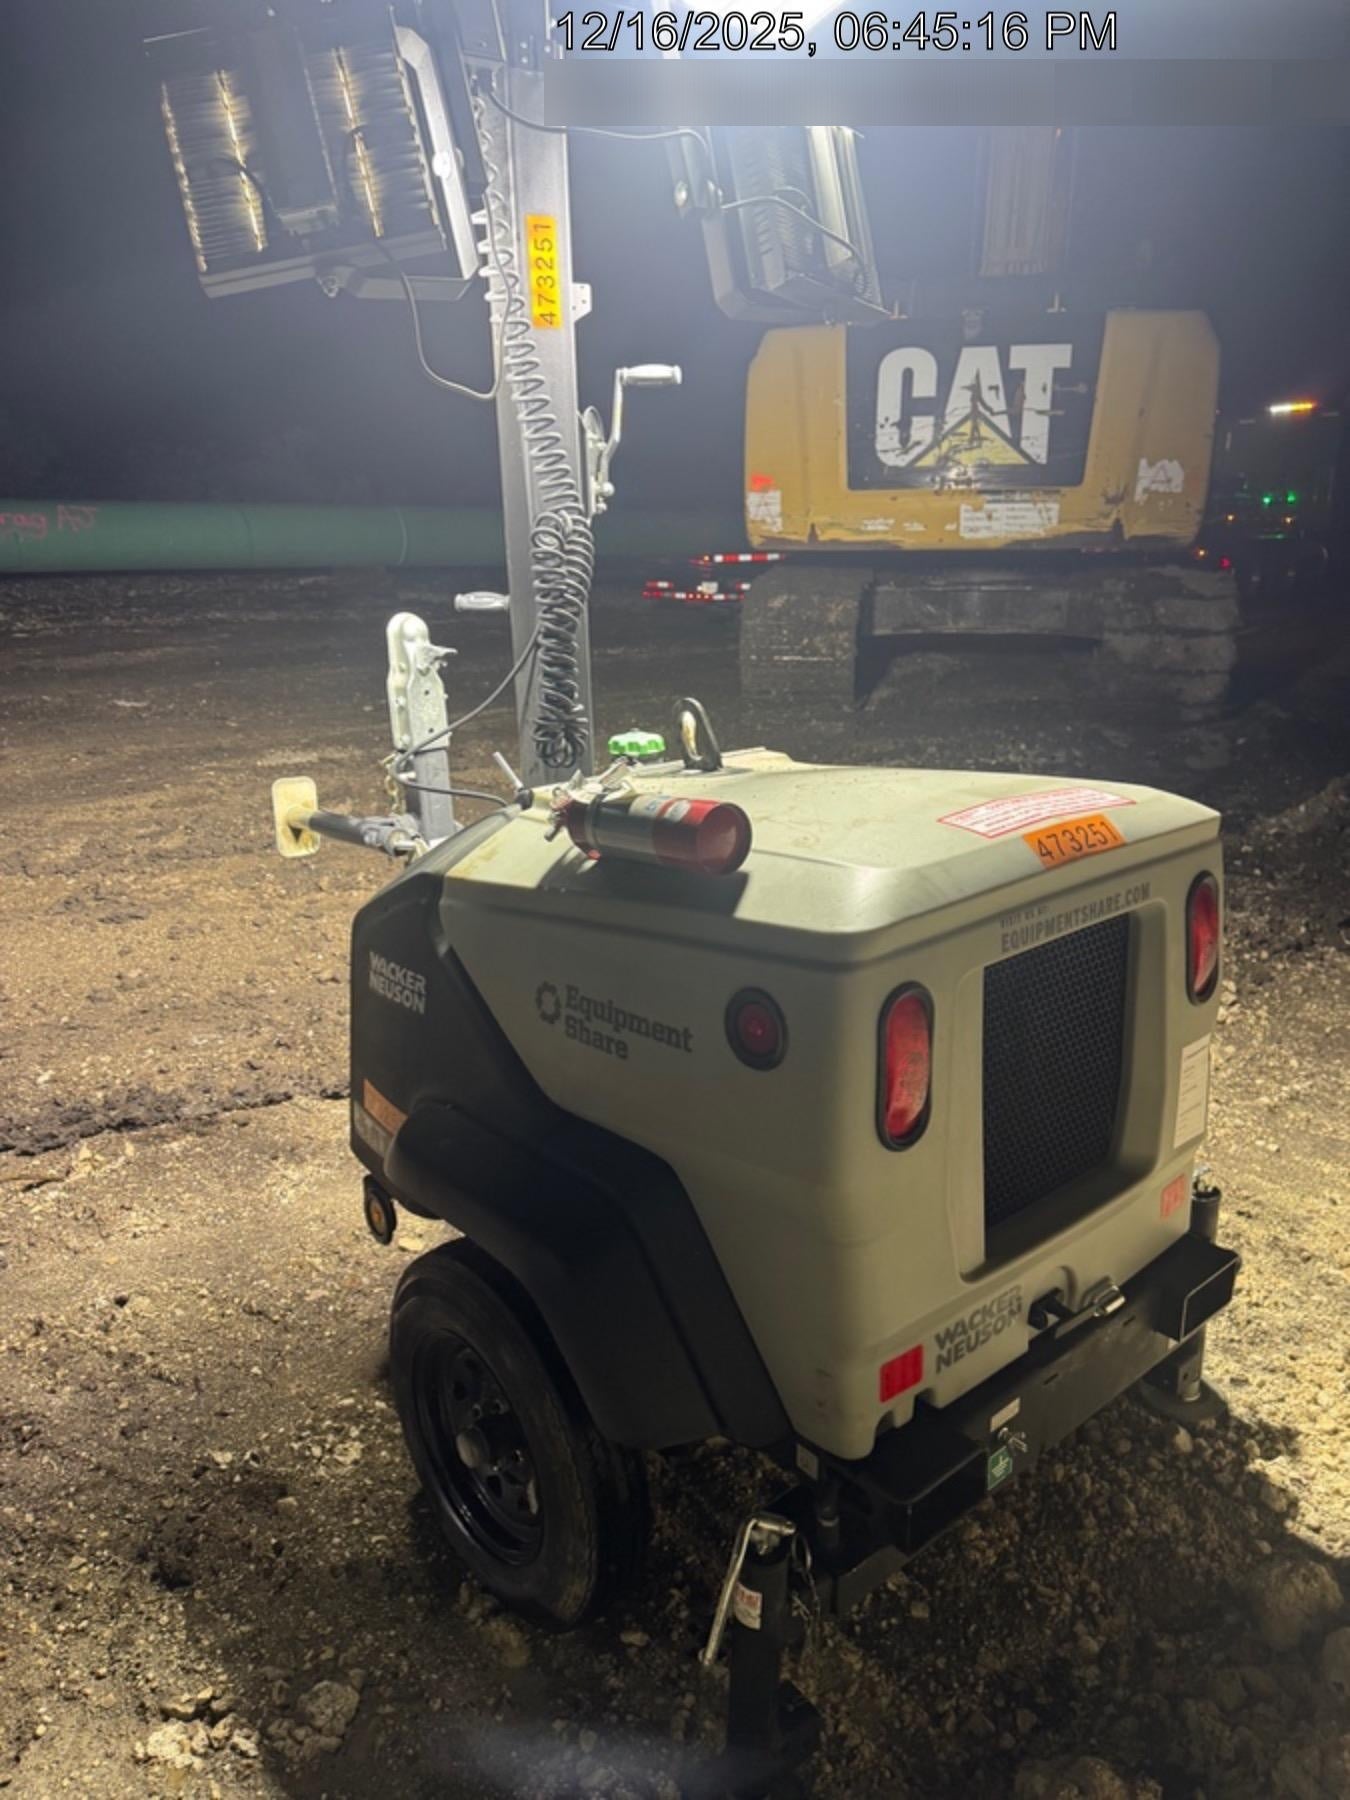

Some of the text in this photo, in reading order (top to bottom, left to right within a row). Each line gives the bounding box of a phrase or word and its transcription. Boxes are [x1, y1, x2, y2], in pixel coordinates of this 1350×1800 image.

[533, 223, 557, 326] 473251
[875, 343, 1073, 468] CAT
[1036, 820, 1119, 861] 473251
[368, 973, 426, 1015] NEUSON
[369, 951, 427, 994] WACKER
[564, 984, 694, 1053] Equipment
[564, 1015, 630, 1061] Share
[933, 1284, 1023, 1352] WACKER
[935, 1302, 1023, 1374] NEUSON
